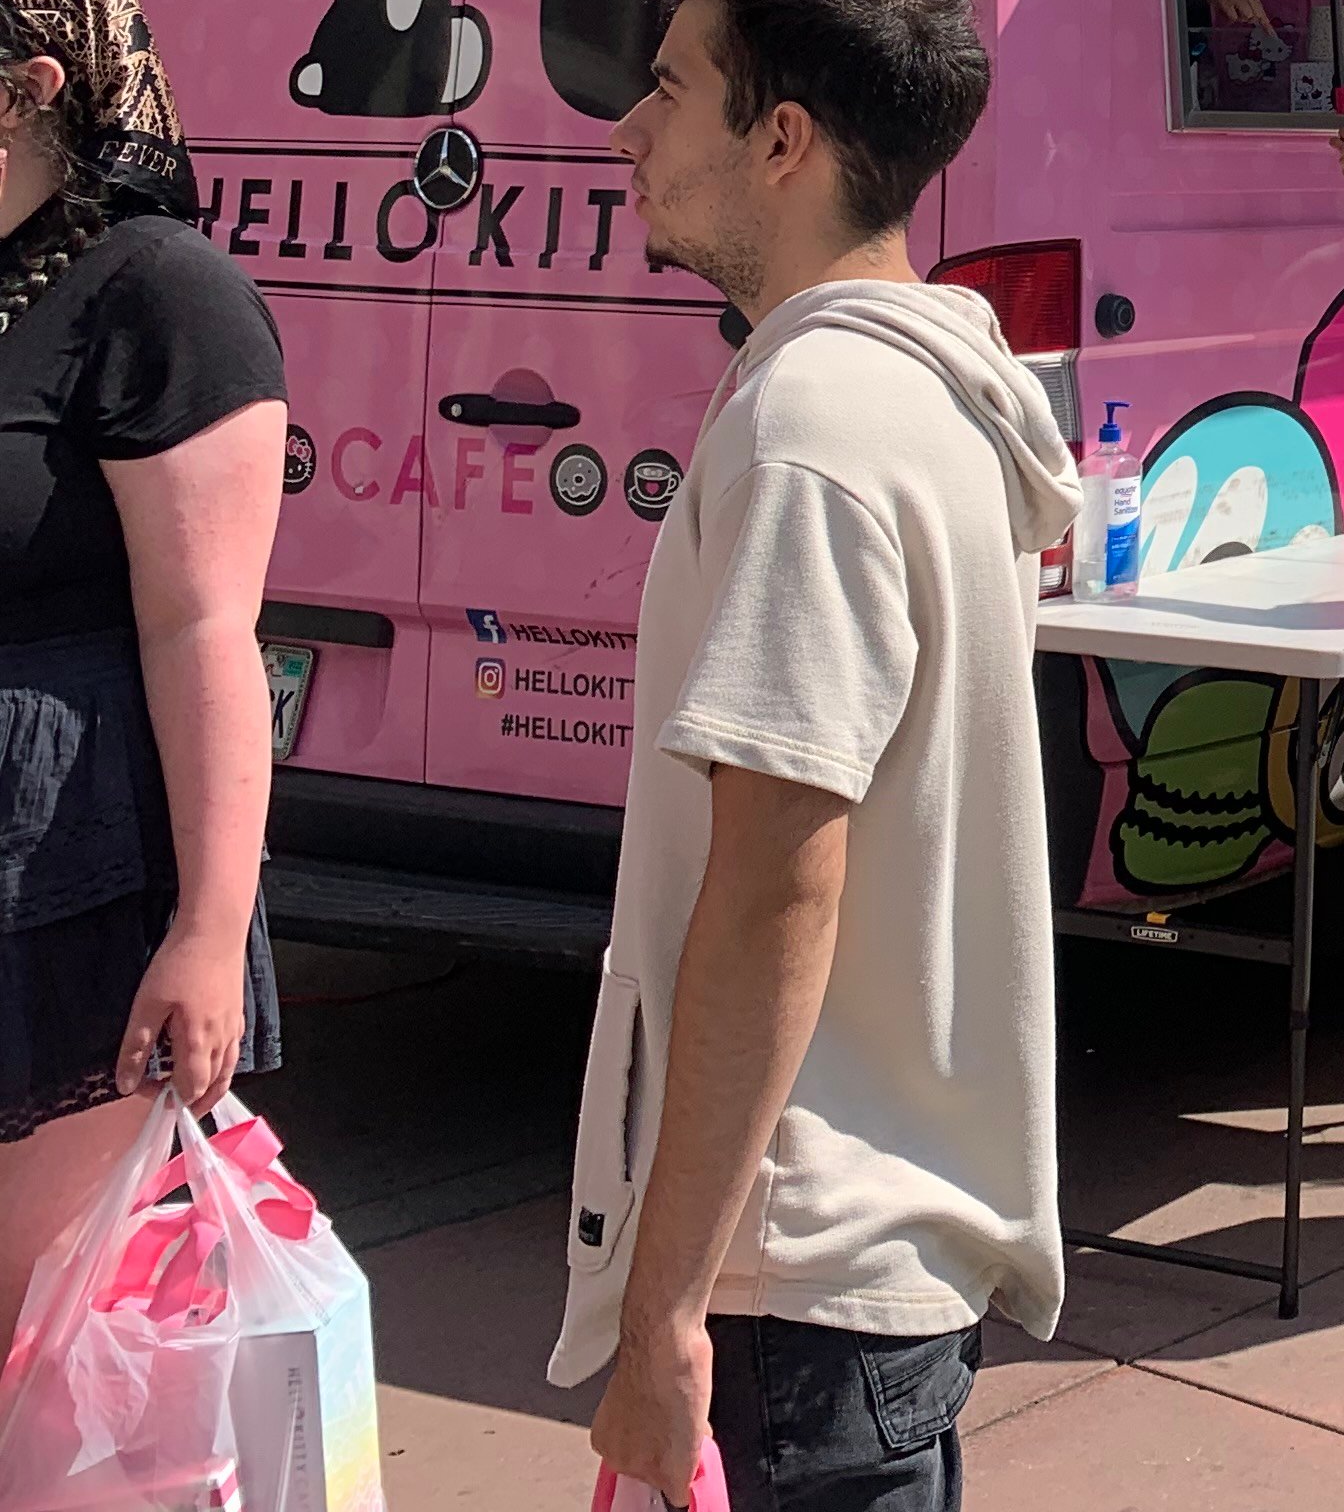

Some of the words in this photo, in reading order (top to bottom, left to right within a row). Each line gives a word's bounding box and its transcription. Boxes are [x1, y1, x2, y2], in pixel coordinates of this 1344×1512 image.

[97, 139, 179, 181] FEVER
[468, 183, 664, 274] KIT
[331, 426, 536, 515] CAFE
[1114, 497, 1131, 507] Hand
[515, 668, 635, 701] HELLOKIT
[501, 714, 634, 748] #HELLOKIT
[1136, 928, 1174, 942] LIFETIME
